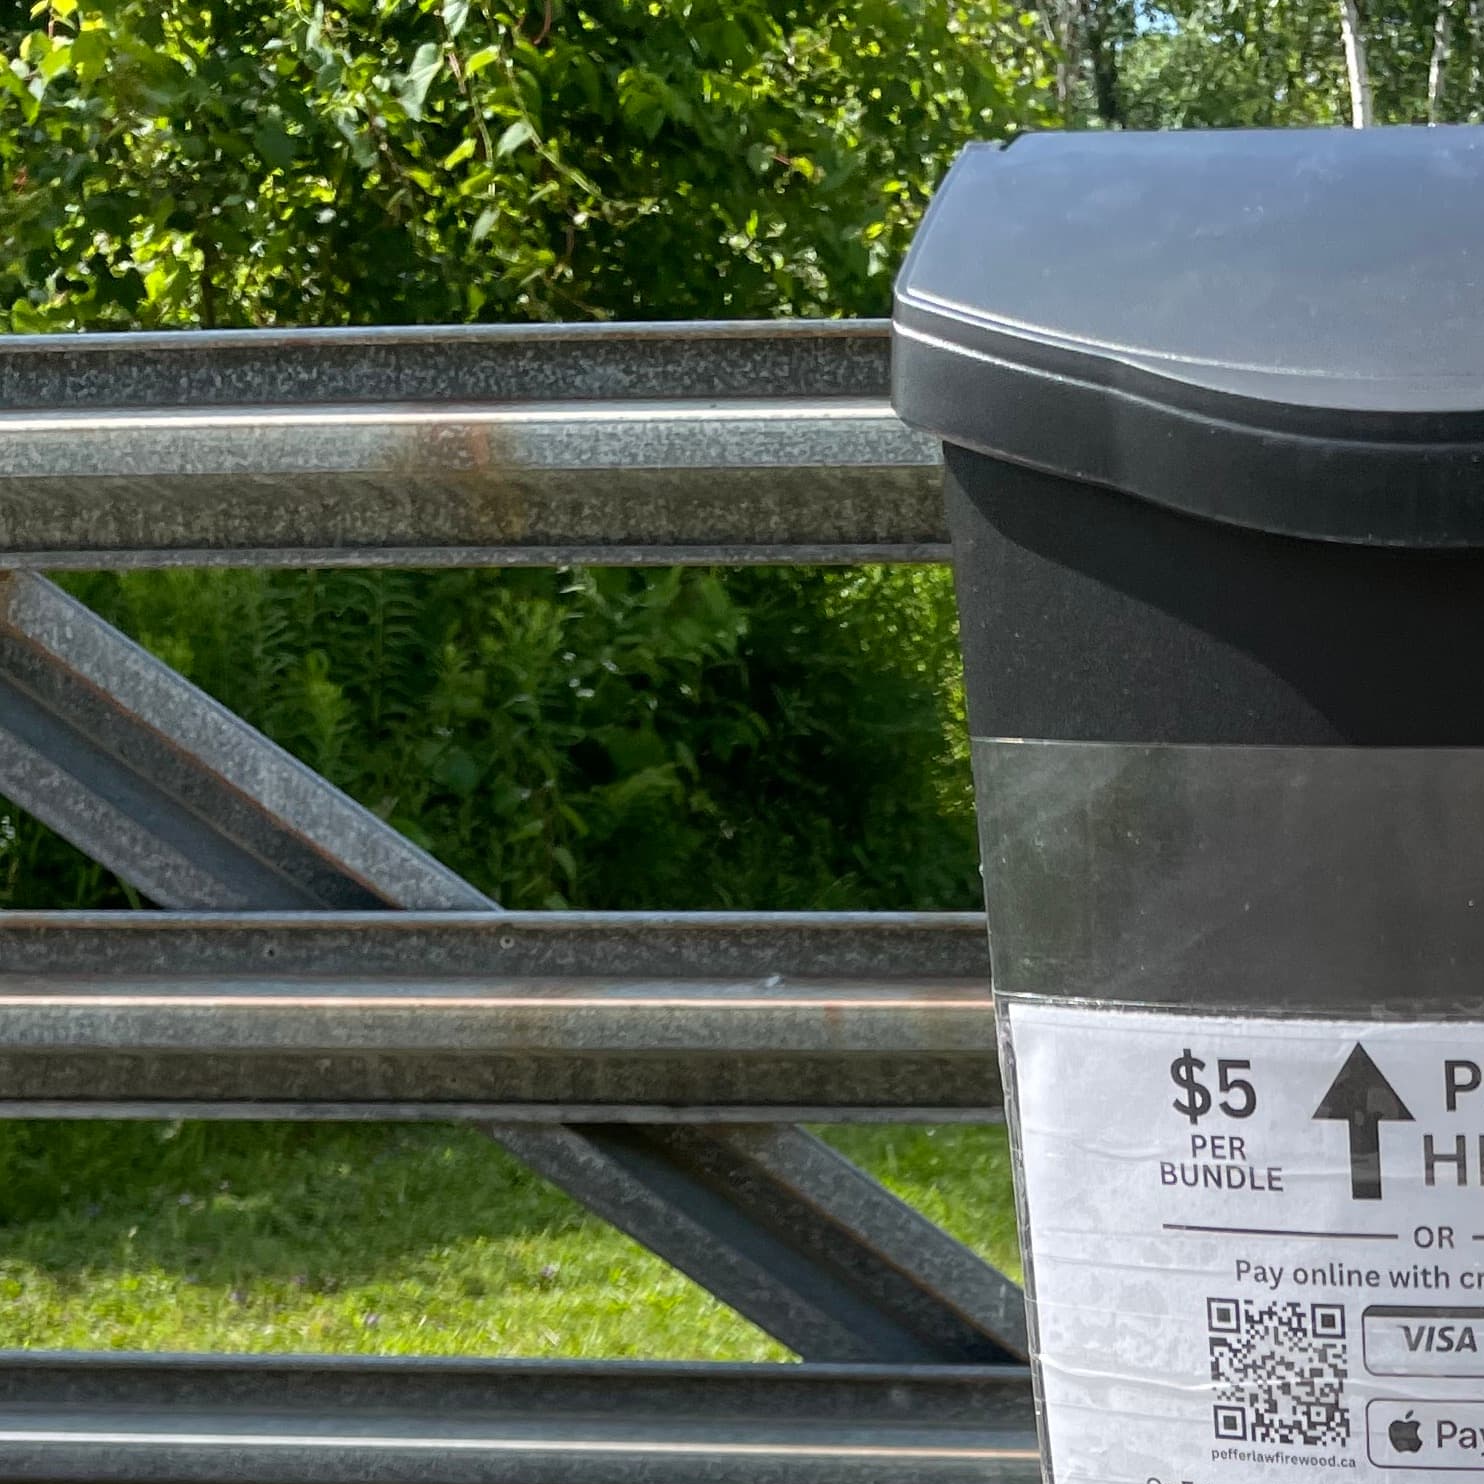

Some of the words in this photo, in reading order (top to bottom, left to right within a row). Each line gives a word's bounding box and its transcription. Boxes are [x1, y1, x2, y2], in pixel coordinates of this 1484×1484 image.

[1170, 1048, 1257, 1125] $5
[1191, 1134, 1246, 1160] PER
[1160, 1161, 1284, 1192] BUNDLE
[1413, 1226, 1455, 1249] OR
[1235, 1259, 1284, 1289] Pay
[1294, 1264, 1381, 1289] online
[1389, 1265, 1451, 1289] with
[1402, 1325, 1478, 1353] VISA
[1211, 1447, 1357, 1469] pefferlawfirewood.ca
